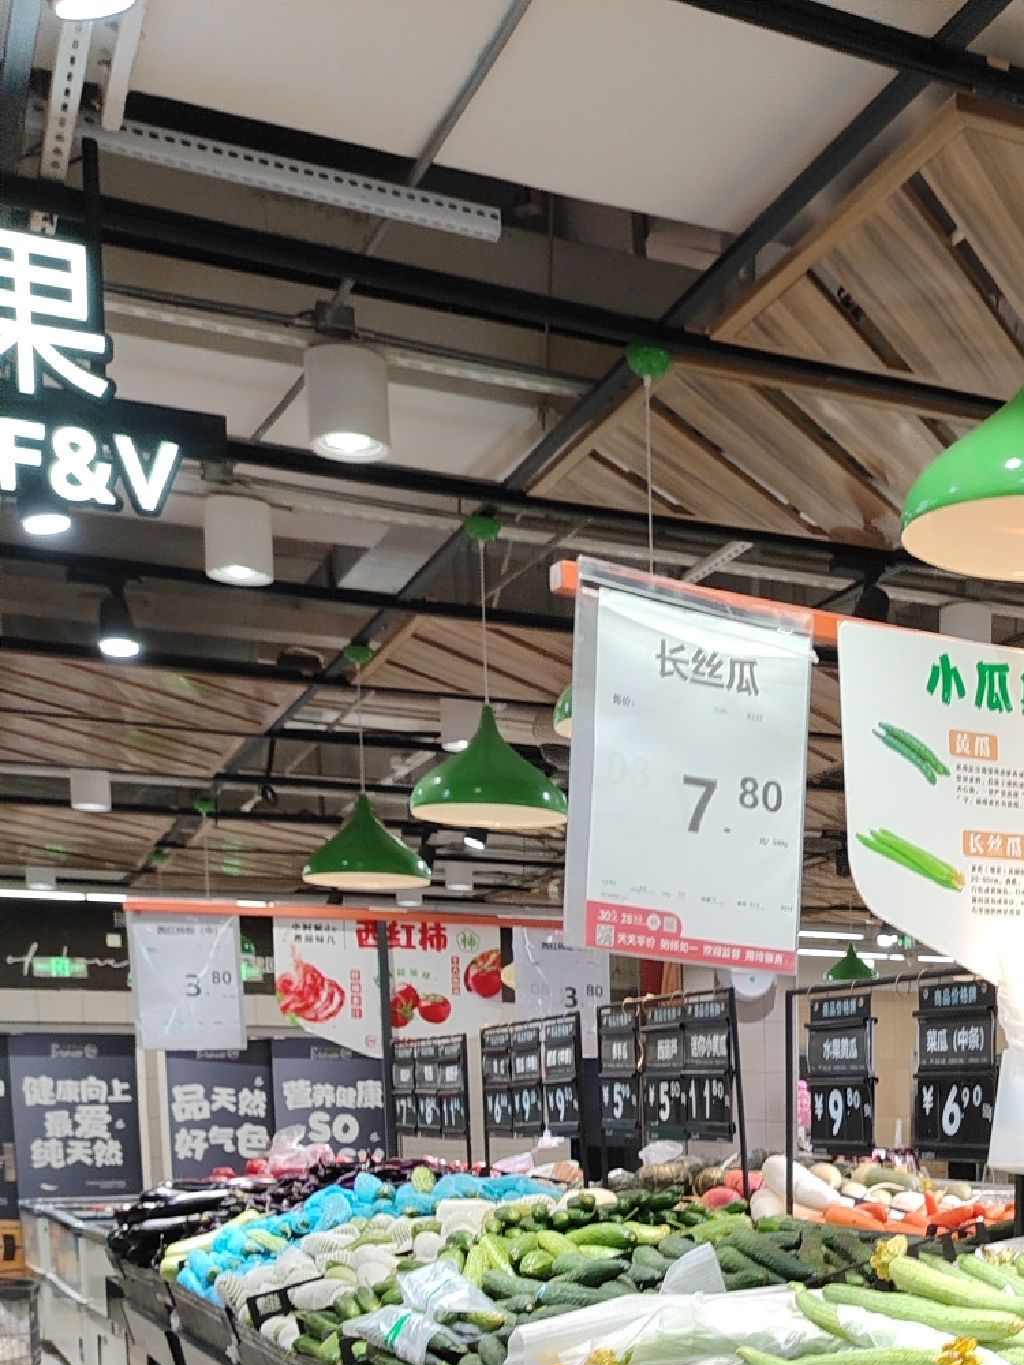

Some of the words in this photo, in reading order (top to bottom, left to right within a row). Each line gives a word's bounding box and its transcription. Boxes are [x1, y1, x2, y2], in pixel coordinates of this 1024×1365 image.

[655, 638, 759, 697] 长丝瓜
[955, 732, 991, 758] 黄瓜
[970, 832, 1023, 858] 长丝瓜
[22, 1076, 132, 1107] 健康向上
[171, 1083, 267, 1123] 品天然
[283, 1077, 384, 1111] 营养健康
[175, 1122, 270, 1162] 好气色
[308, 1111, 360, 1144] SO
